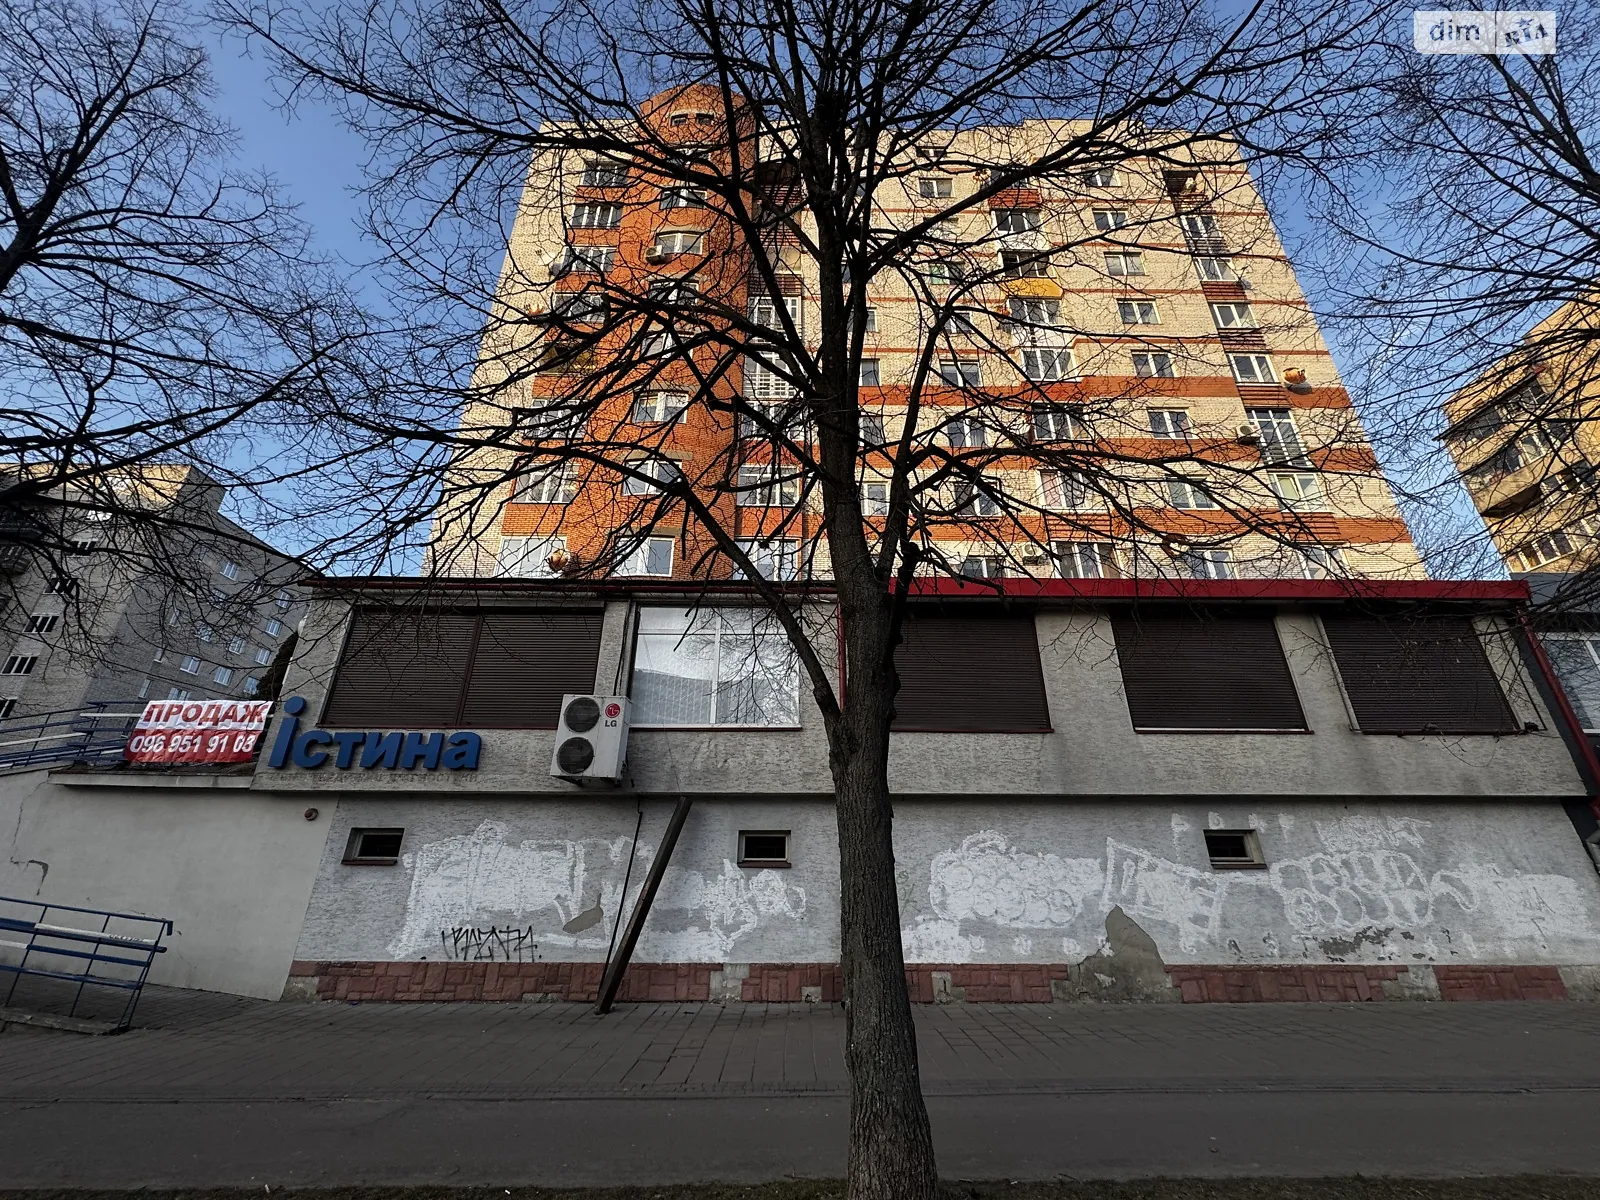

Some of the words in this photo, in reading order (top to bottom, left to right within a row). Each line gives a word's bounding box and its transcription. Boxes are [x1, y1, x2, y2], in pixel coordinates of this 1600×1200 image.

[143, 704, 270, 726] ПРОДАЖ
[604, 720, 617, 728] LG
[129, 735, 165, 753] 096
[168, 735, 203, 753] 951
[206, 735, 226, 753] 91
